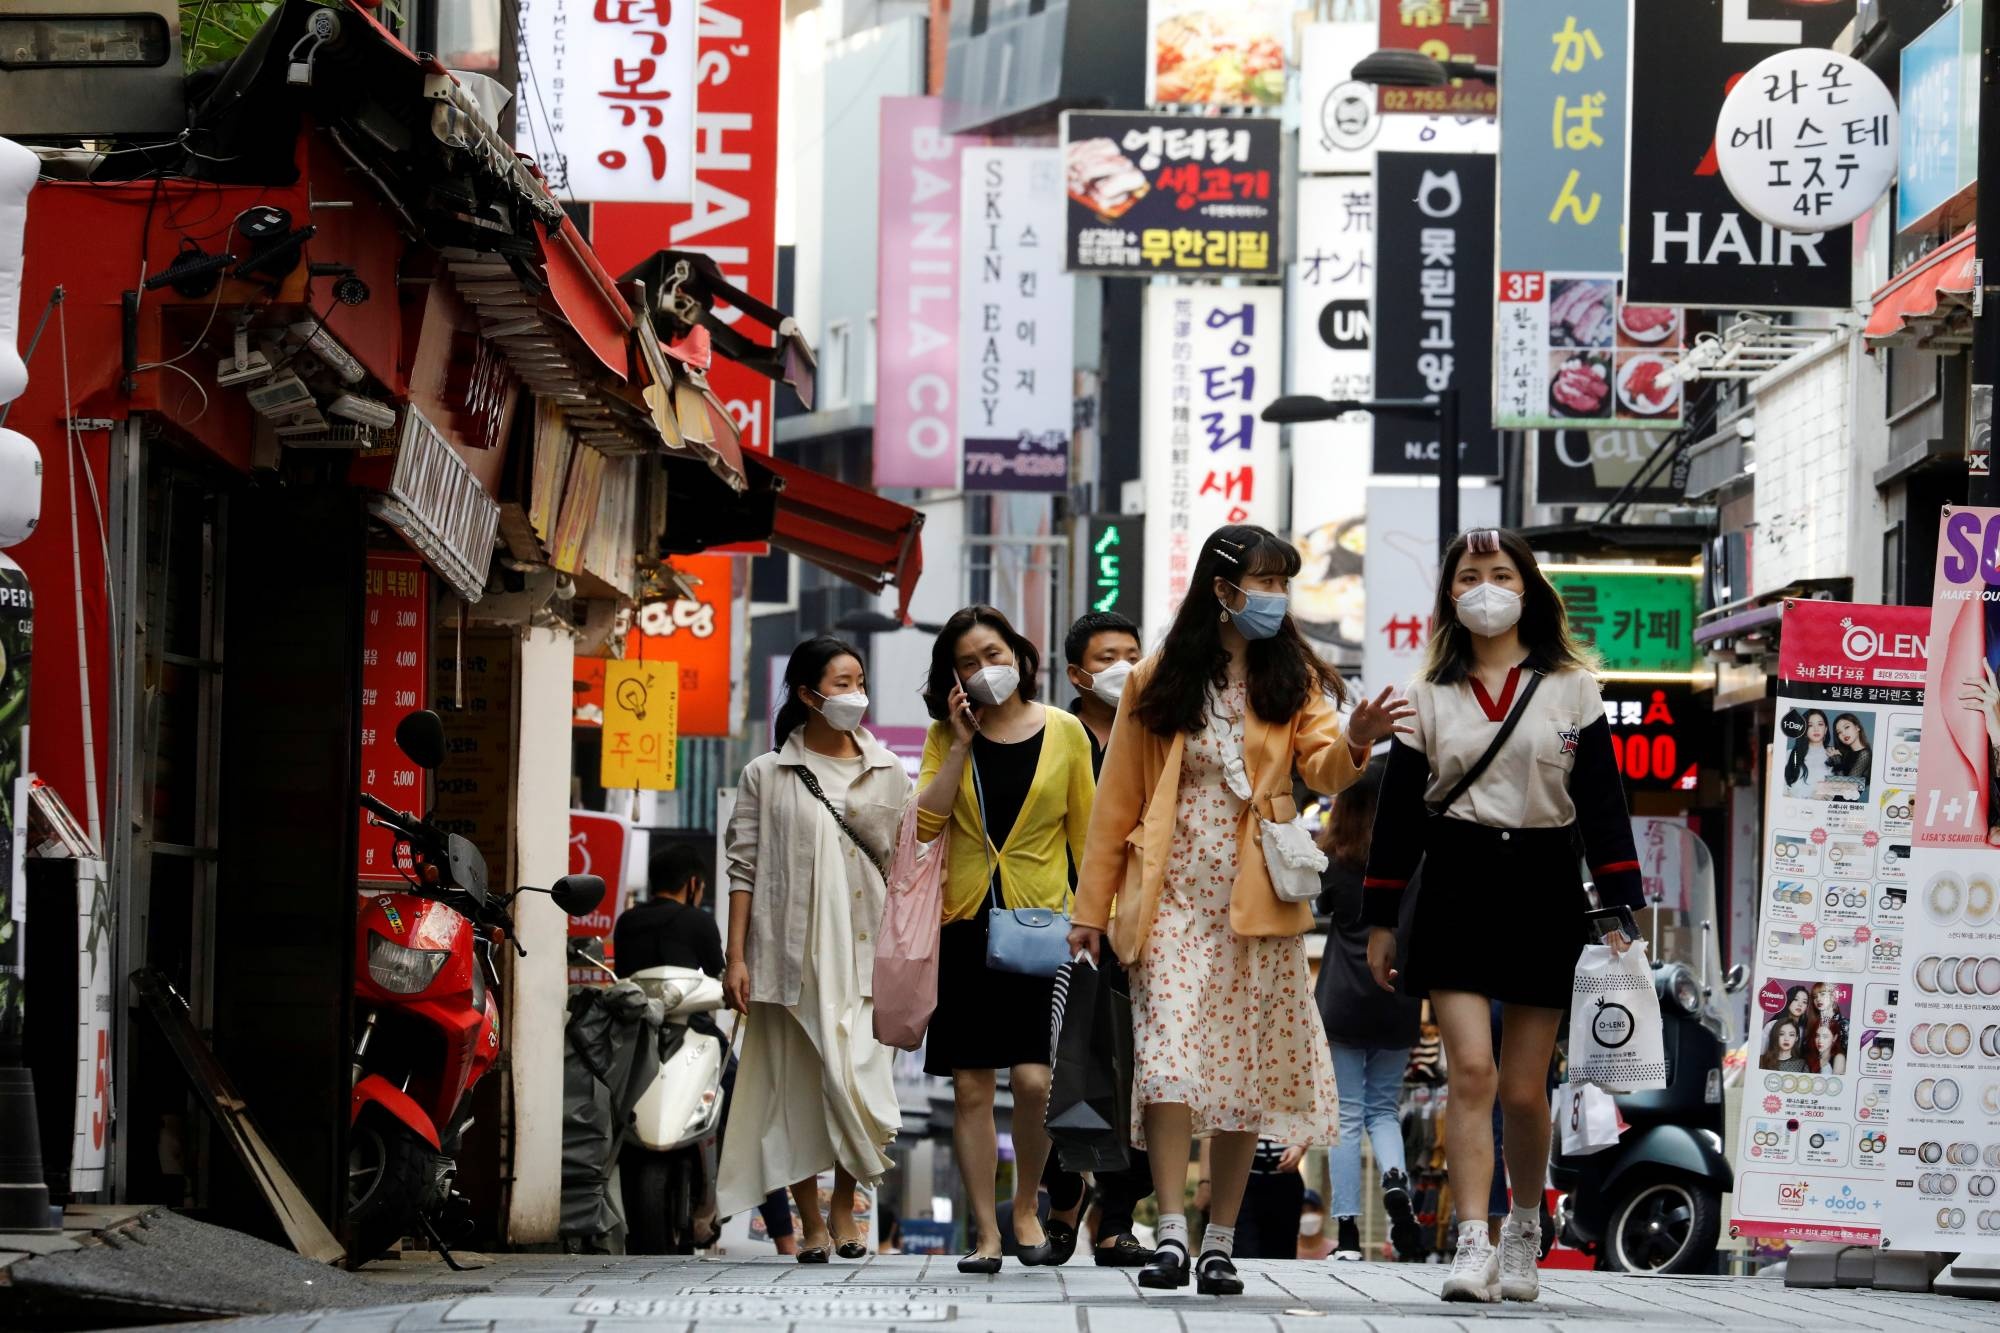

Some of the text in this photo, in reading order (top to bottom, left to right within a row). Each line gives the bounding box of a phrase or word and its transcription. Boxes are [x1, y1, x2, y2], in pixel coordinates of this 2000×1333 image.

[593, 0, 671, 181] 떡볶이
[1763, 62, 1852, 105] 라온
[1549, 16, 1606, 225] かばん
[1731, 115, 1889, 150] 에스테
[1768, 154, 1860, 189] エステ
[1156, 163, 1270, 211] 생고기
[1793, 192, 1833, 216] 4F
[1141, 228, 1269, 269] 무한리필
[906, 126, 952, 459] BANILA CO
[980, 160, 1003, 426] SKIN EASY
[1507, 274, 1541, 300] 3F
[1417, 228, 1456, 401] 못된고양
[1200, 303, 1256, 452] 엉터리
[1405, 441, 1468, 460] N.CT
[1199, 472, 1254, 526] 생
[1940, 590, 2000, 602] MAKE YOU
[396, 612, 417, 627] 3,000
[395, 651, 417, 667] 4,000
[1796, 664, 1815, 677] 국내
[1817, 664, 1844, 678] 최다
[1845, 669, 1865, 680] 보유
[395, 691, 416, 707] 3,000
[1831, 686, 1864, 700] 일회용
[1868, 688, 1912, 702] 칼라렌즈
[1783, 721, 1804, 731] 1-Day
[610, 732, 663, 771] 주의
[393, 771, 415, 787] 5,000
[1924, 789, 1979, 828] 1+1
[1921, 833, 1946, 843] LISA'S
[1948, 834, 1973, 844] SCANDI
[1599, 1021, 1626, 1029] O-LENS
[1782, 1187, 1866, 1211] OK dodo
